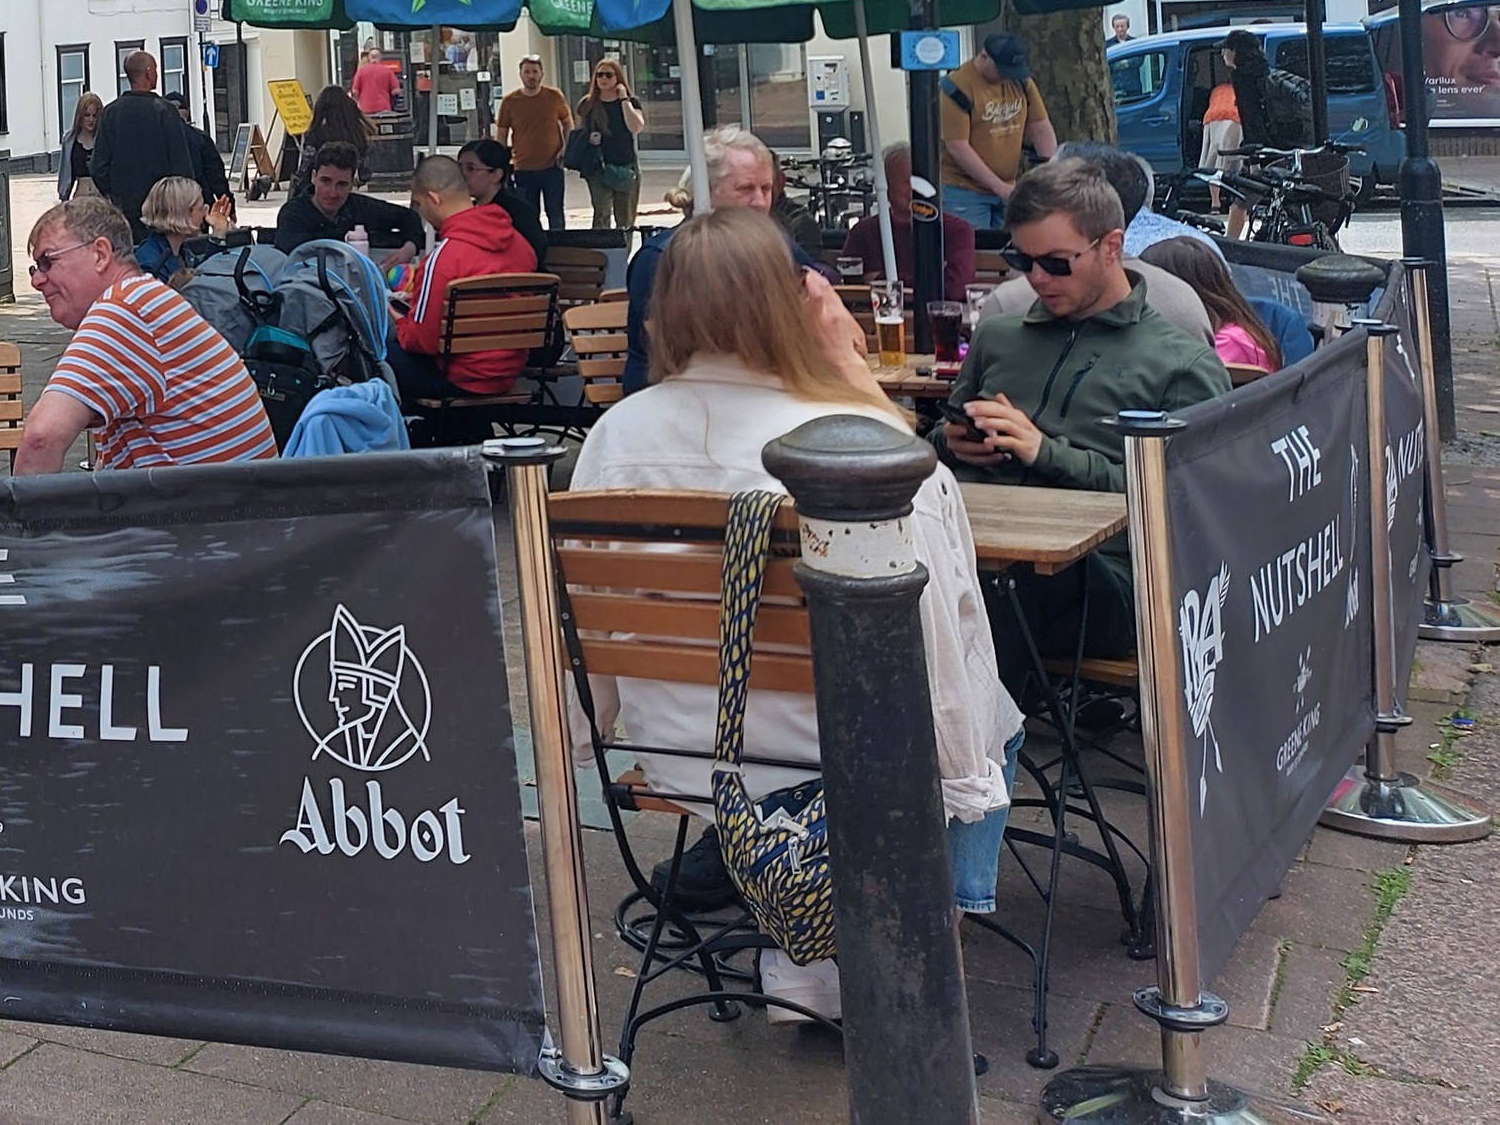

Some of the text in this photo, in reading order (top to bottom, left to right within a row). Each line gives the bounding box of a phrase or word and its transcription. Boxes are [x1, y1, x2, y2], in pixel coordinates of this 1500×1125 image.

[1438, 85, 1459, 94] lens
[1271, 425, 1323, 503] THE
[1250, 514, 1344, 643] NUTSHELL
[1179, 575, 1225, 713] IPA
[278, 776, 472, 865] Abbot
[0, 874, 87, 905] KING
